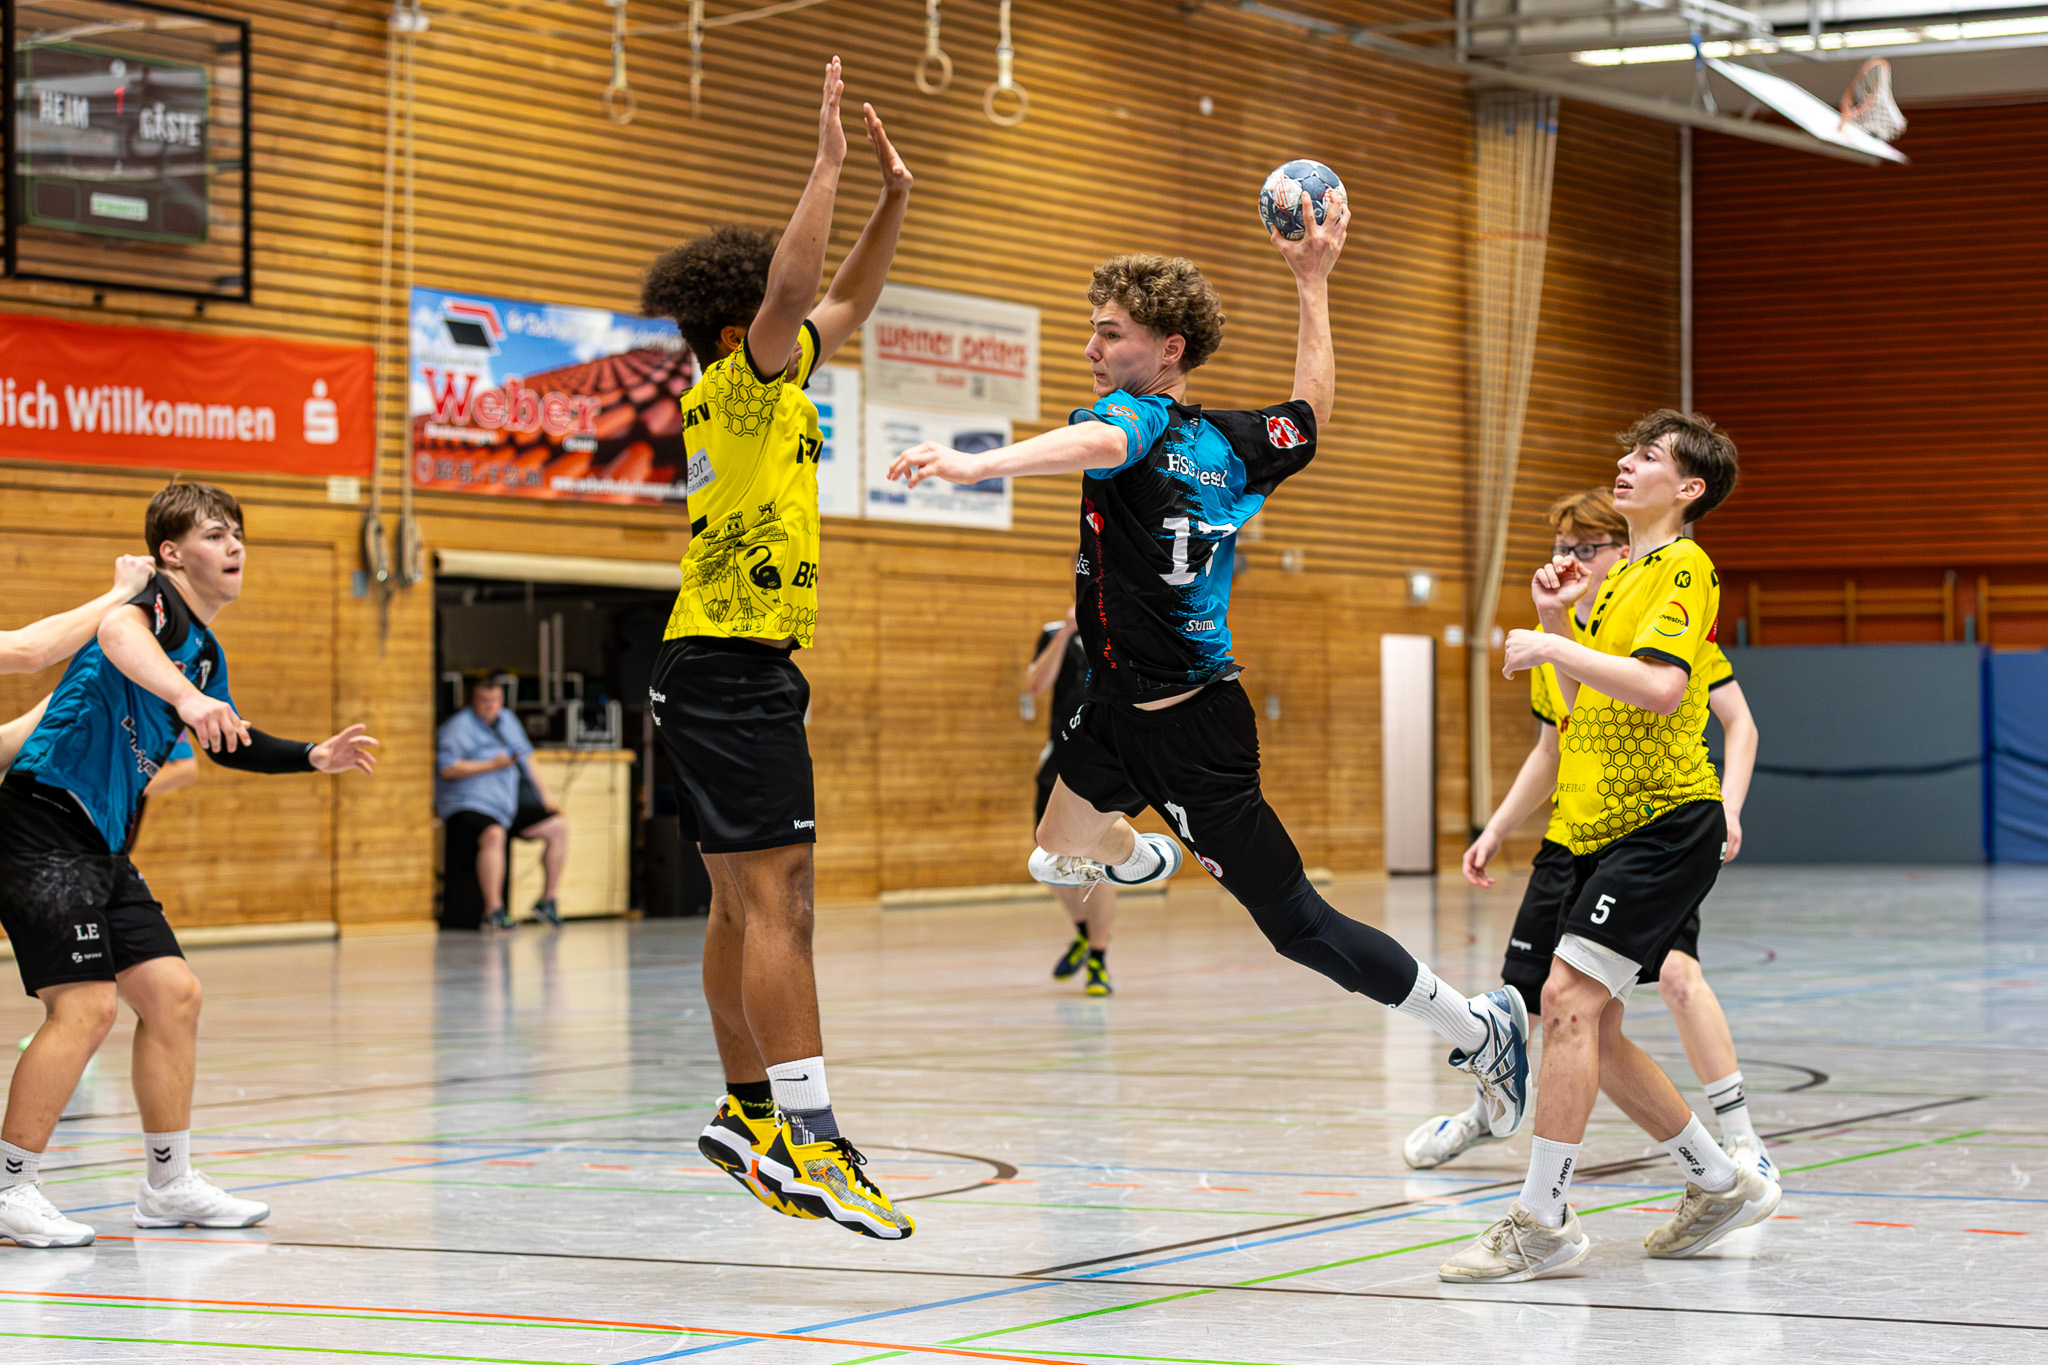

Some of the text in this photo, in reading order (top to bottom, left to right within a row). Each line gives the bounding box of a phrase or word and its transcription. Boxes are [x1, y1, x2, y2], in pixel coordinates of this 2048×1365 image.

[64, 384, 276, 442] Willkommen
[421, 366, 602, 437] Weber
[1166, 453, 1228, 489] HSG esel
[1159, 516, 1238, 586] 17
[1590, 893, 1617, 925] 5
[73, 923, 100, 941] LE
[1559, 1156, 1573, 1188] CRAFT
[1678, 1145, 1700, 1168] CRAFT
